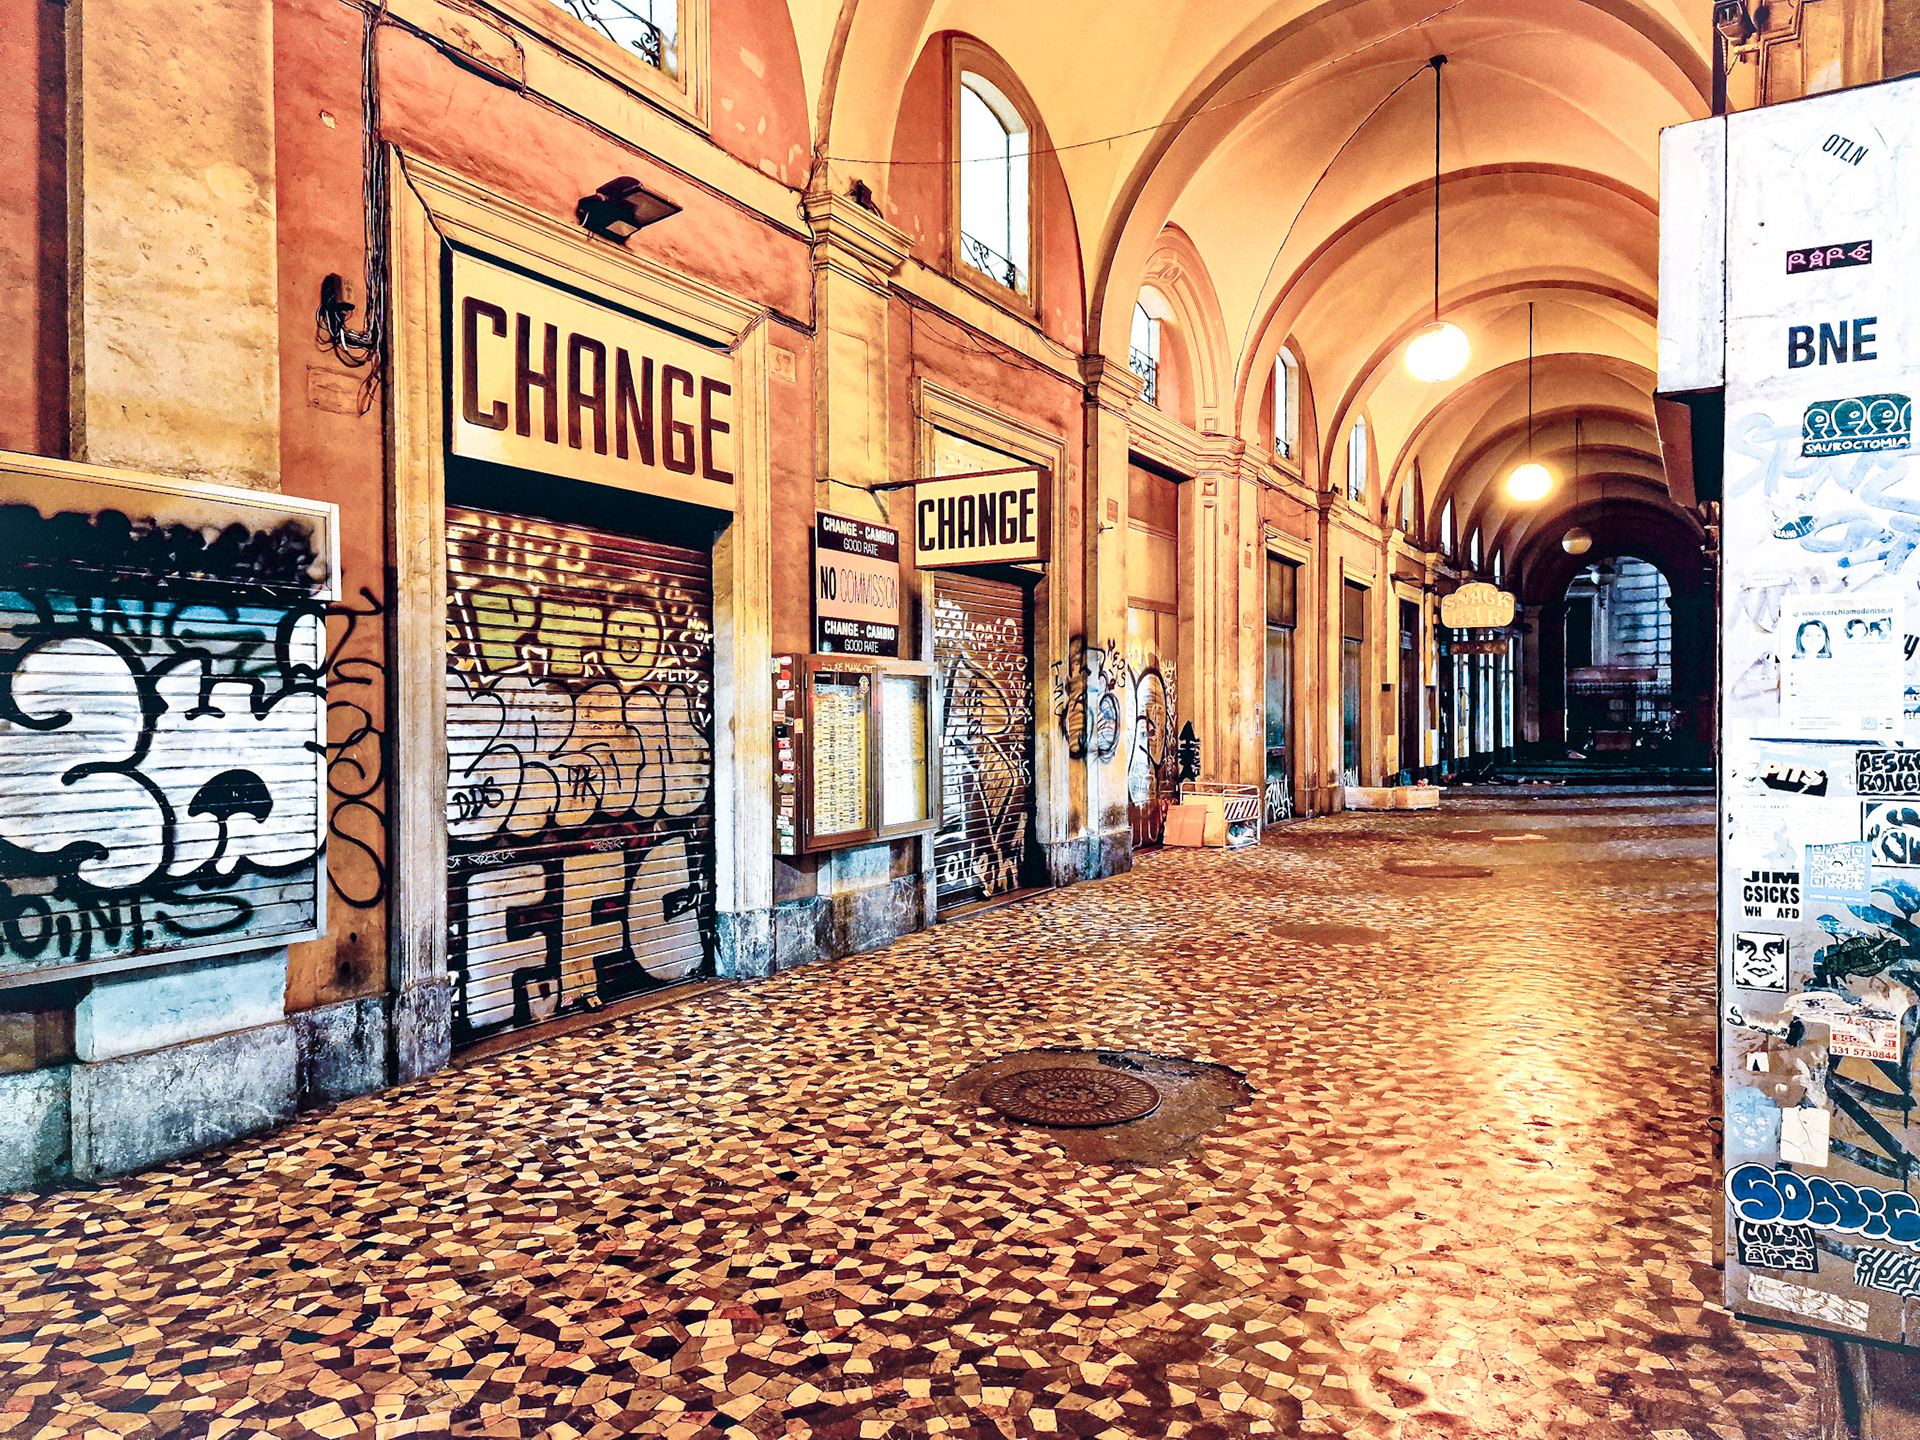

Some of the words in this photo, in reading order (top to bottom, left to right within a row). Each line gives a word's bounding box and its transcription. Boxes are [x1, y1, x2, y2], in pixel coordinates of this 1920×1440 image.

[1822, 133, 1869, 167] OTLN
[1788, 316, 1878, 369] BNE
[462, 296, 734, 485] CHANGE
[823, 516, 857, 537] CHANGE
[865, 526, 895, 545] CAMBIO
[918, 488, 1036, 552] CHANGE
[843, 537, 862, 553] GOOD
[863, 541, 879, 556] RATE
[820, 565, 836, 601] NO
[839, 568, 899, 610] COMMISSION
[1443, 587, 1512, 611] SNACK
[1451, 606, 1505, 626] BAR
[824, 620, 859, 637] CHANGE
[866, 624, 895, 641] CAMBIO
[844, 639, 862, 651] GOOD
[864, 640, 879, 653] RATE
[1743, 870, 1799, 885] JIM
[1744, 905, 1762, 917] WH
[1776, 907, 1799, 919] AFD
[1831, 1045, 1849, 1054] 331
[1853, 1048, 1897, 1060] 5730844
